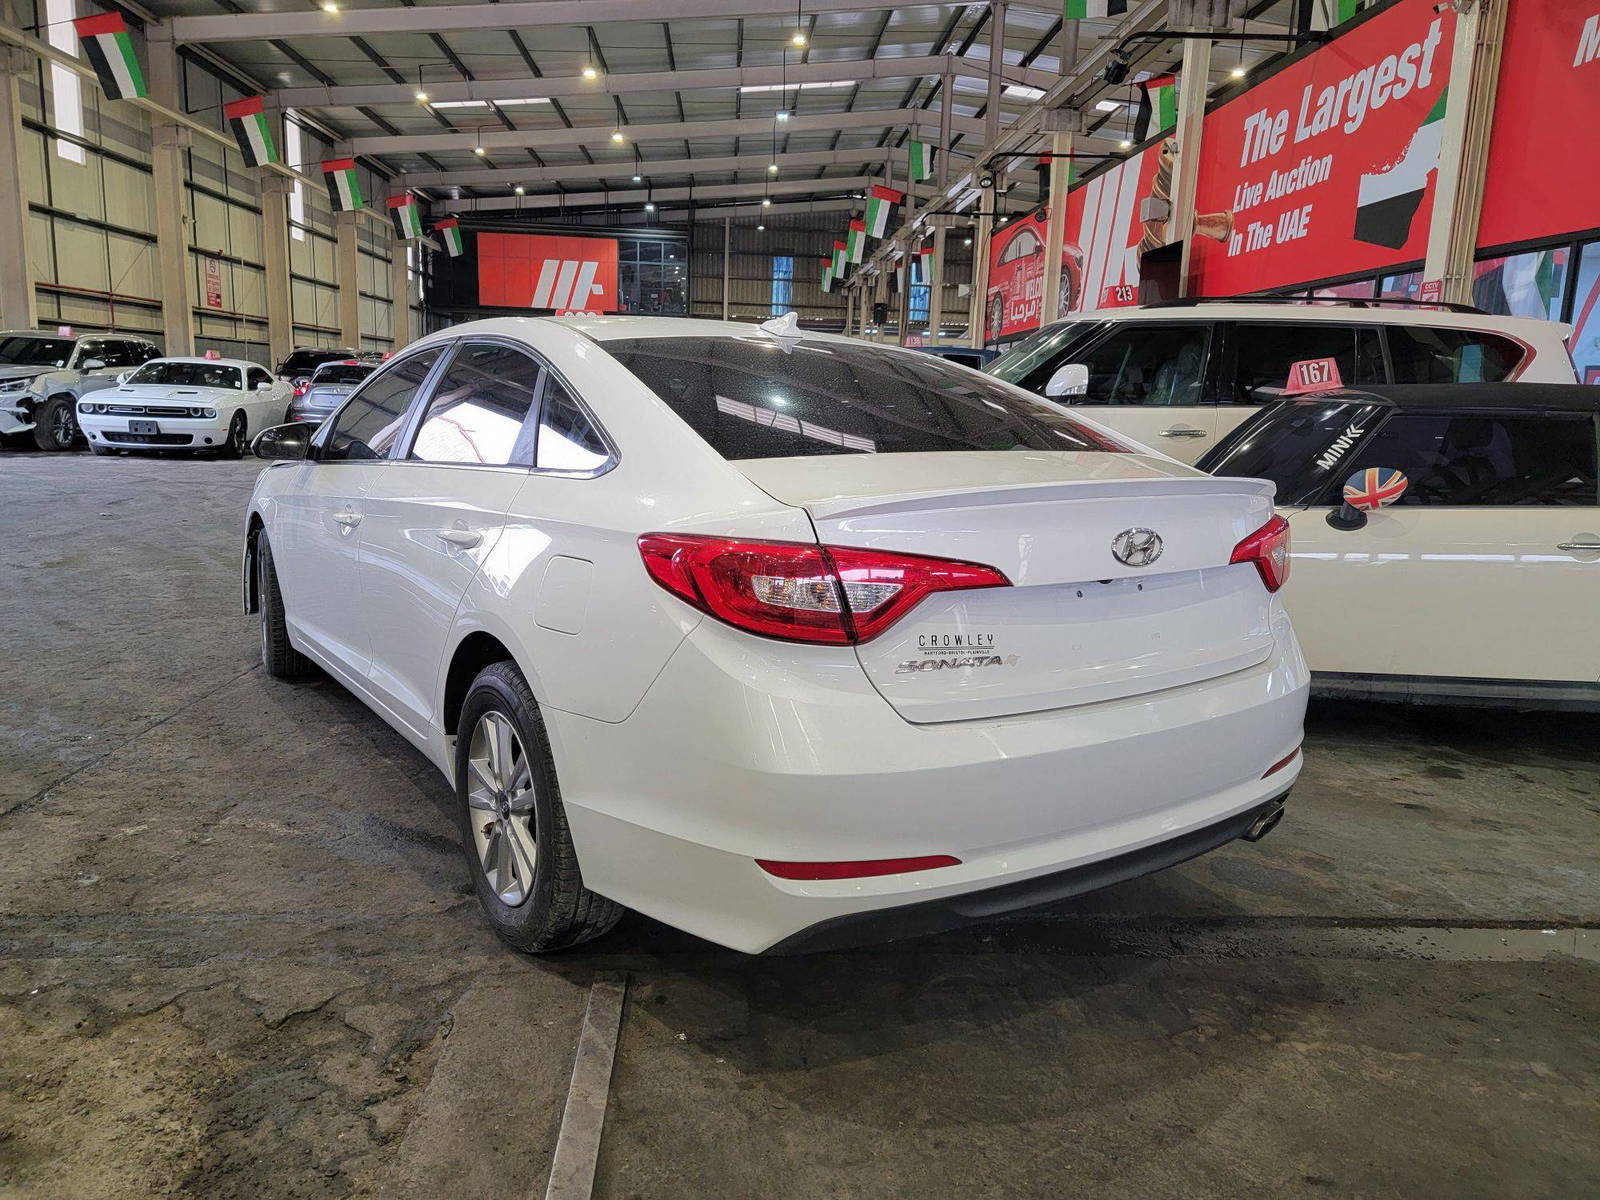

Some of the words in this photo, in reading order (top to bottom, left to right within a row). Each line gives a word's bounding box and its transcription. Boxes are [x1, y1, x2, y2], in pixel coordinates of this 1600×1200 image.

[1240, 108, 1289, 168] The
[1294, 17, 1442, 144] Largest
[1232, 182, 1263, 213] Live
[1264, 154, 1332, 203] Auction
[1228, 229, 1243, 257] In
[1246, 221, 1273, 253] The
[1276, 204, 1313, 244] UAE
[1116, 286, 1133, 302] 213
[1425, 281, 1440, 290] CCTV
[1301, 361, 1329, 385] 167
[918, 634, 994, 647] CROWLEY
[895, 655, 1004, 674] SONATA
